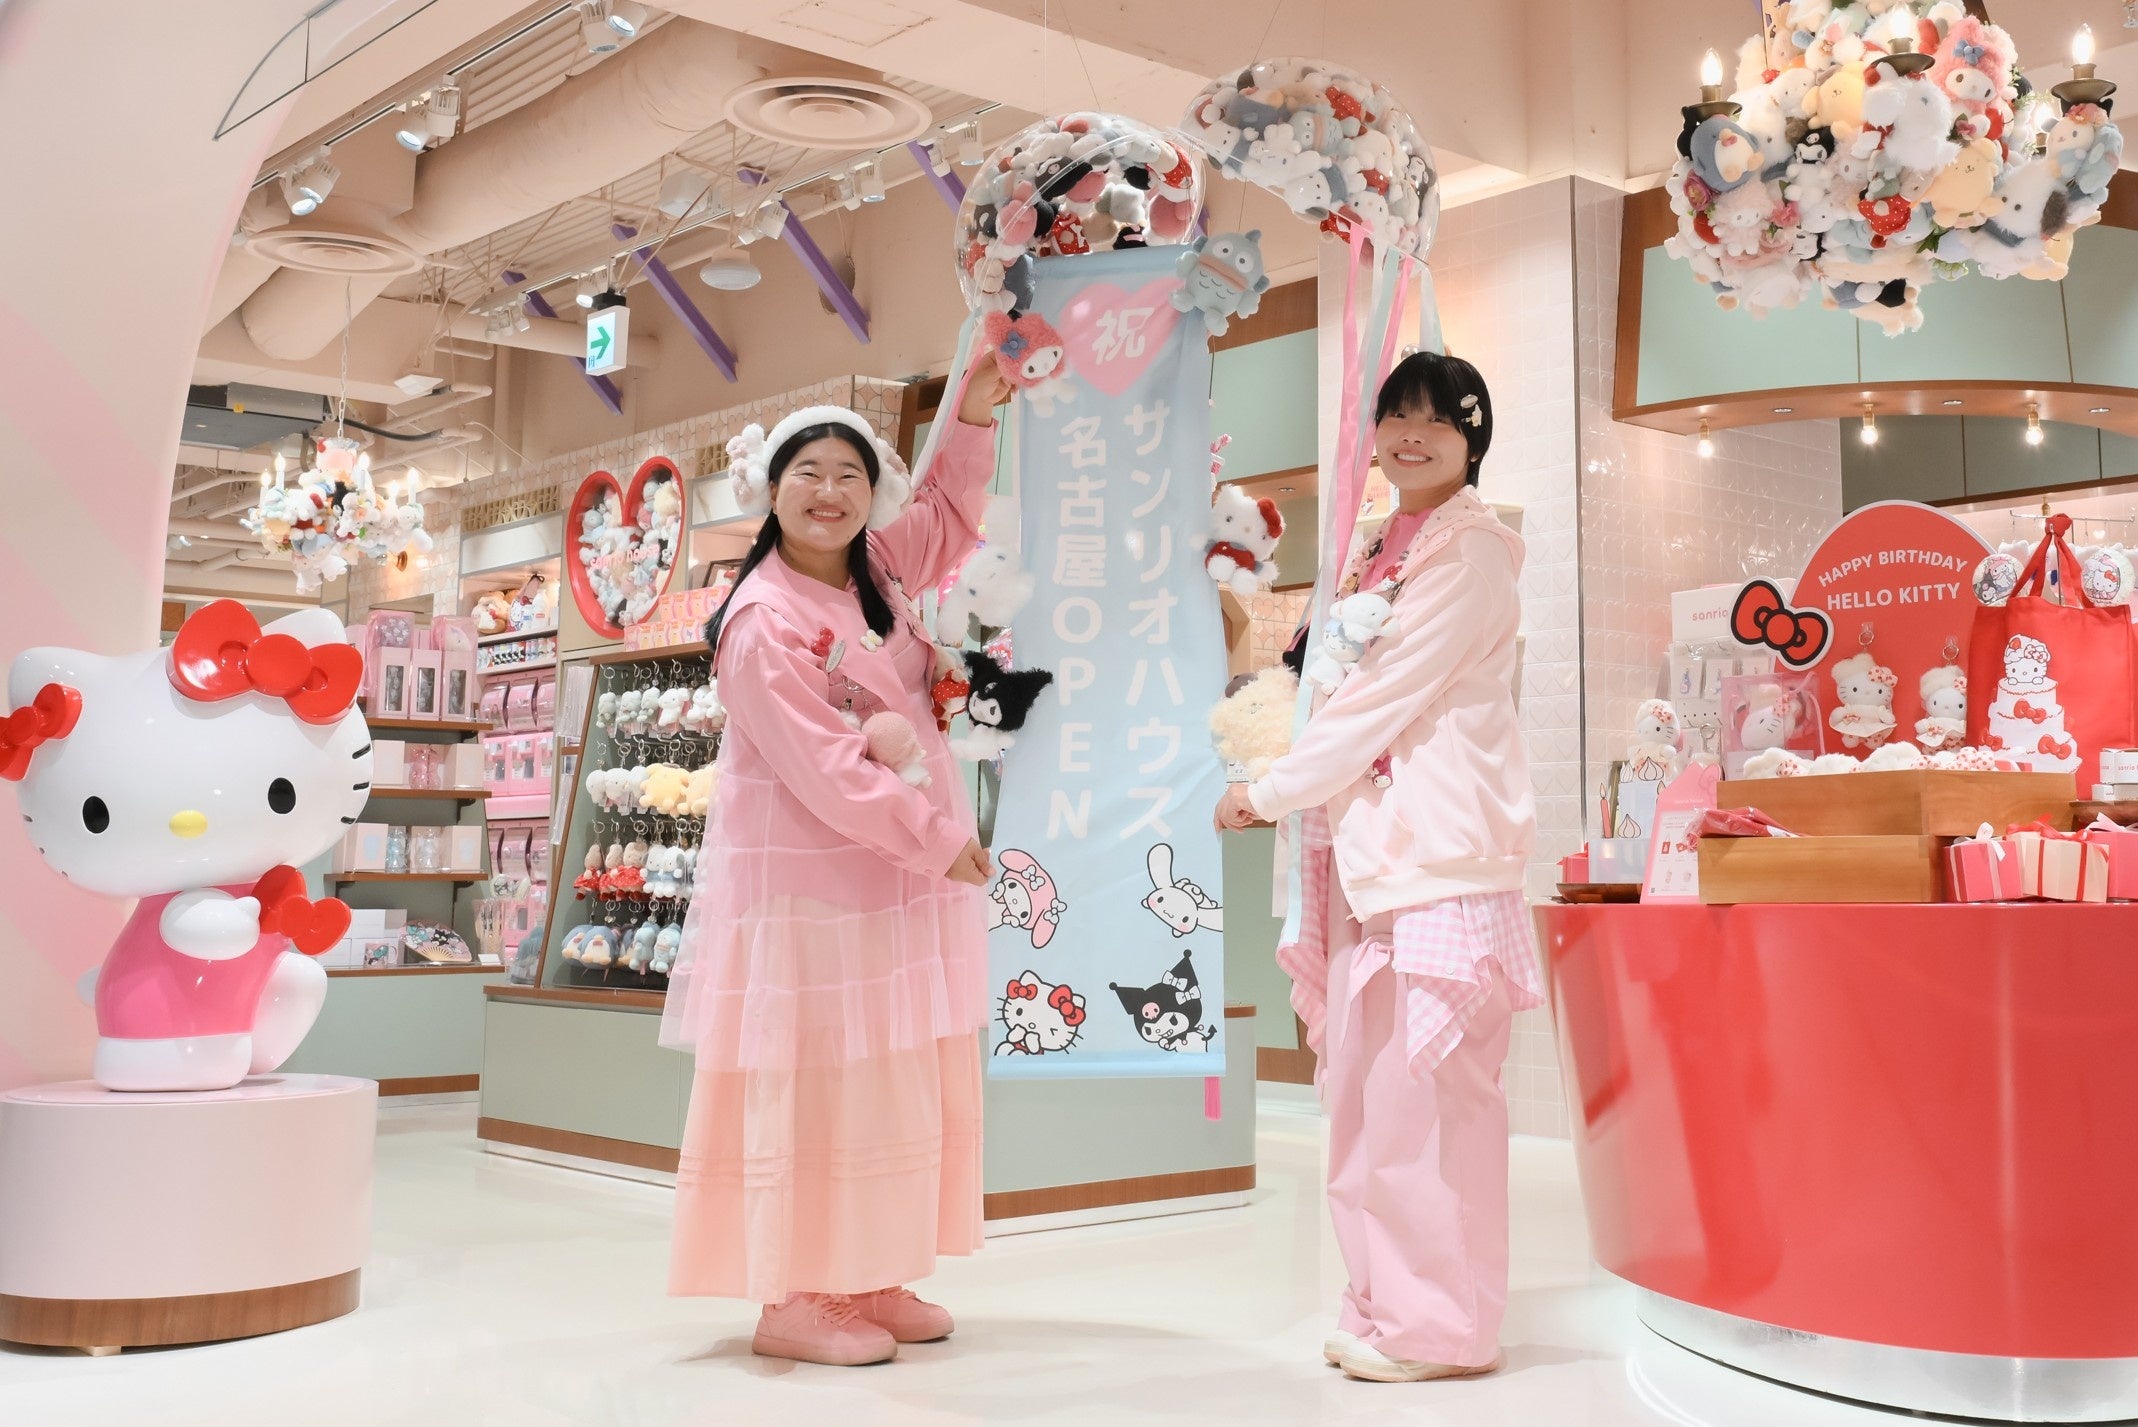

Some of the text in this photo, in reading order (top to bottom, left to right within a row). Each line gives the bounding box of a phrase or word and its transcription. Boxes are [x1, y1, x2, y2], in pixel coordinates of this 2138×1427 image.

[1091, 306, 1156, 366] 祝
[1818, 549, 1968, 588] HAPPY BIRTHDAY
[1119, 400, 1185, 840] サンリオハウス
[1692, 607, 1728, 621] sanrio
[1827, 582, 1961, 610] HELLO KITTY
[1046, 415, 1108, 840] 名古屋OPEN
